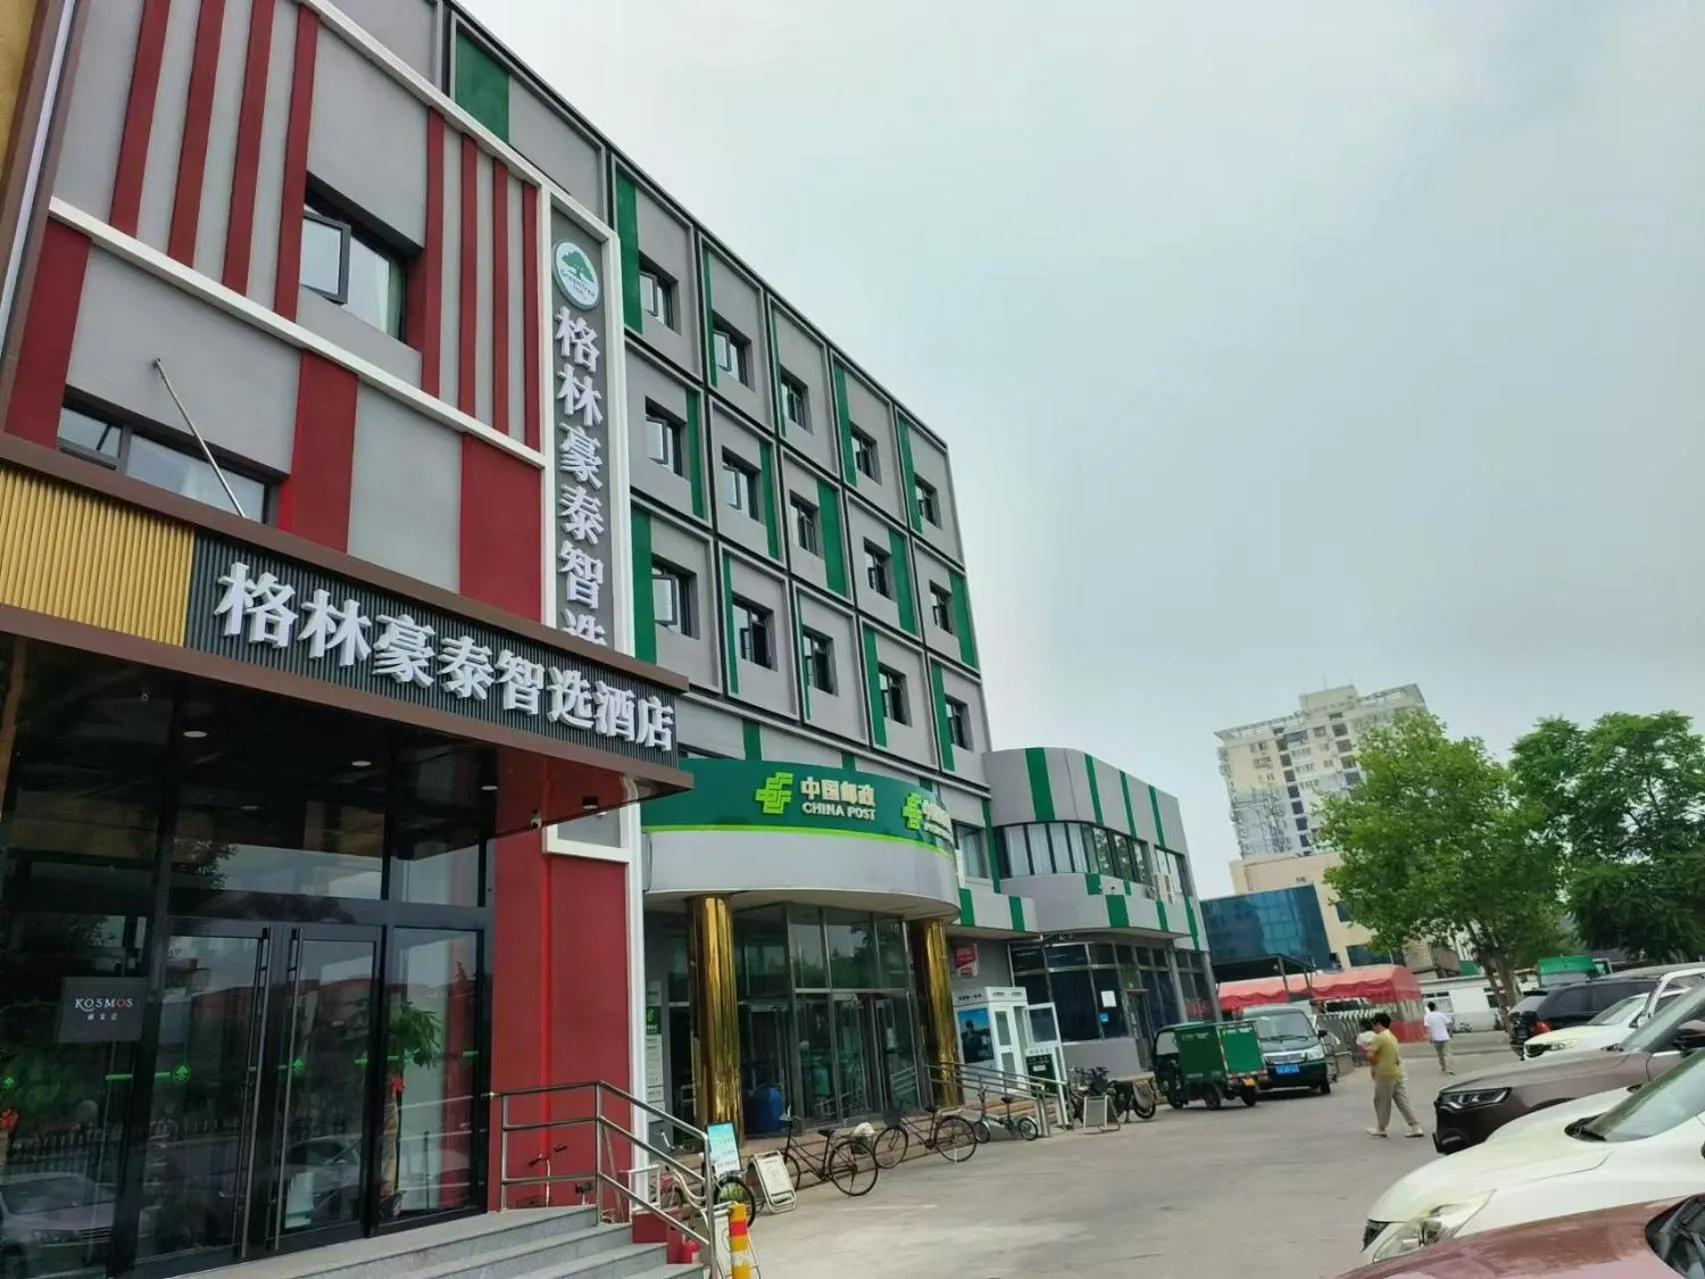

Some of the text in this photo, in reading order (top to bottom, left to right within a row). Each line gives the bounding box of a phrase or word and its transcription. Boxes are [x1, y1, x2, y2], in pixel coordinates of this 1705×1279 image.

[213, 561, 674, 752] 格林豪泰智选酒店
[802, 802, 876, 821] CHINA POST
[74, 998, 133, 1012] KOSMOS
